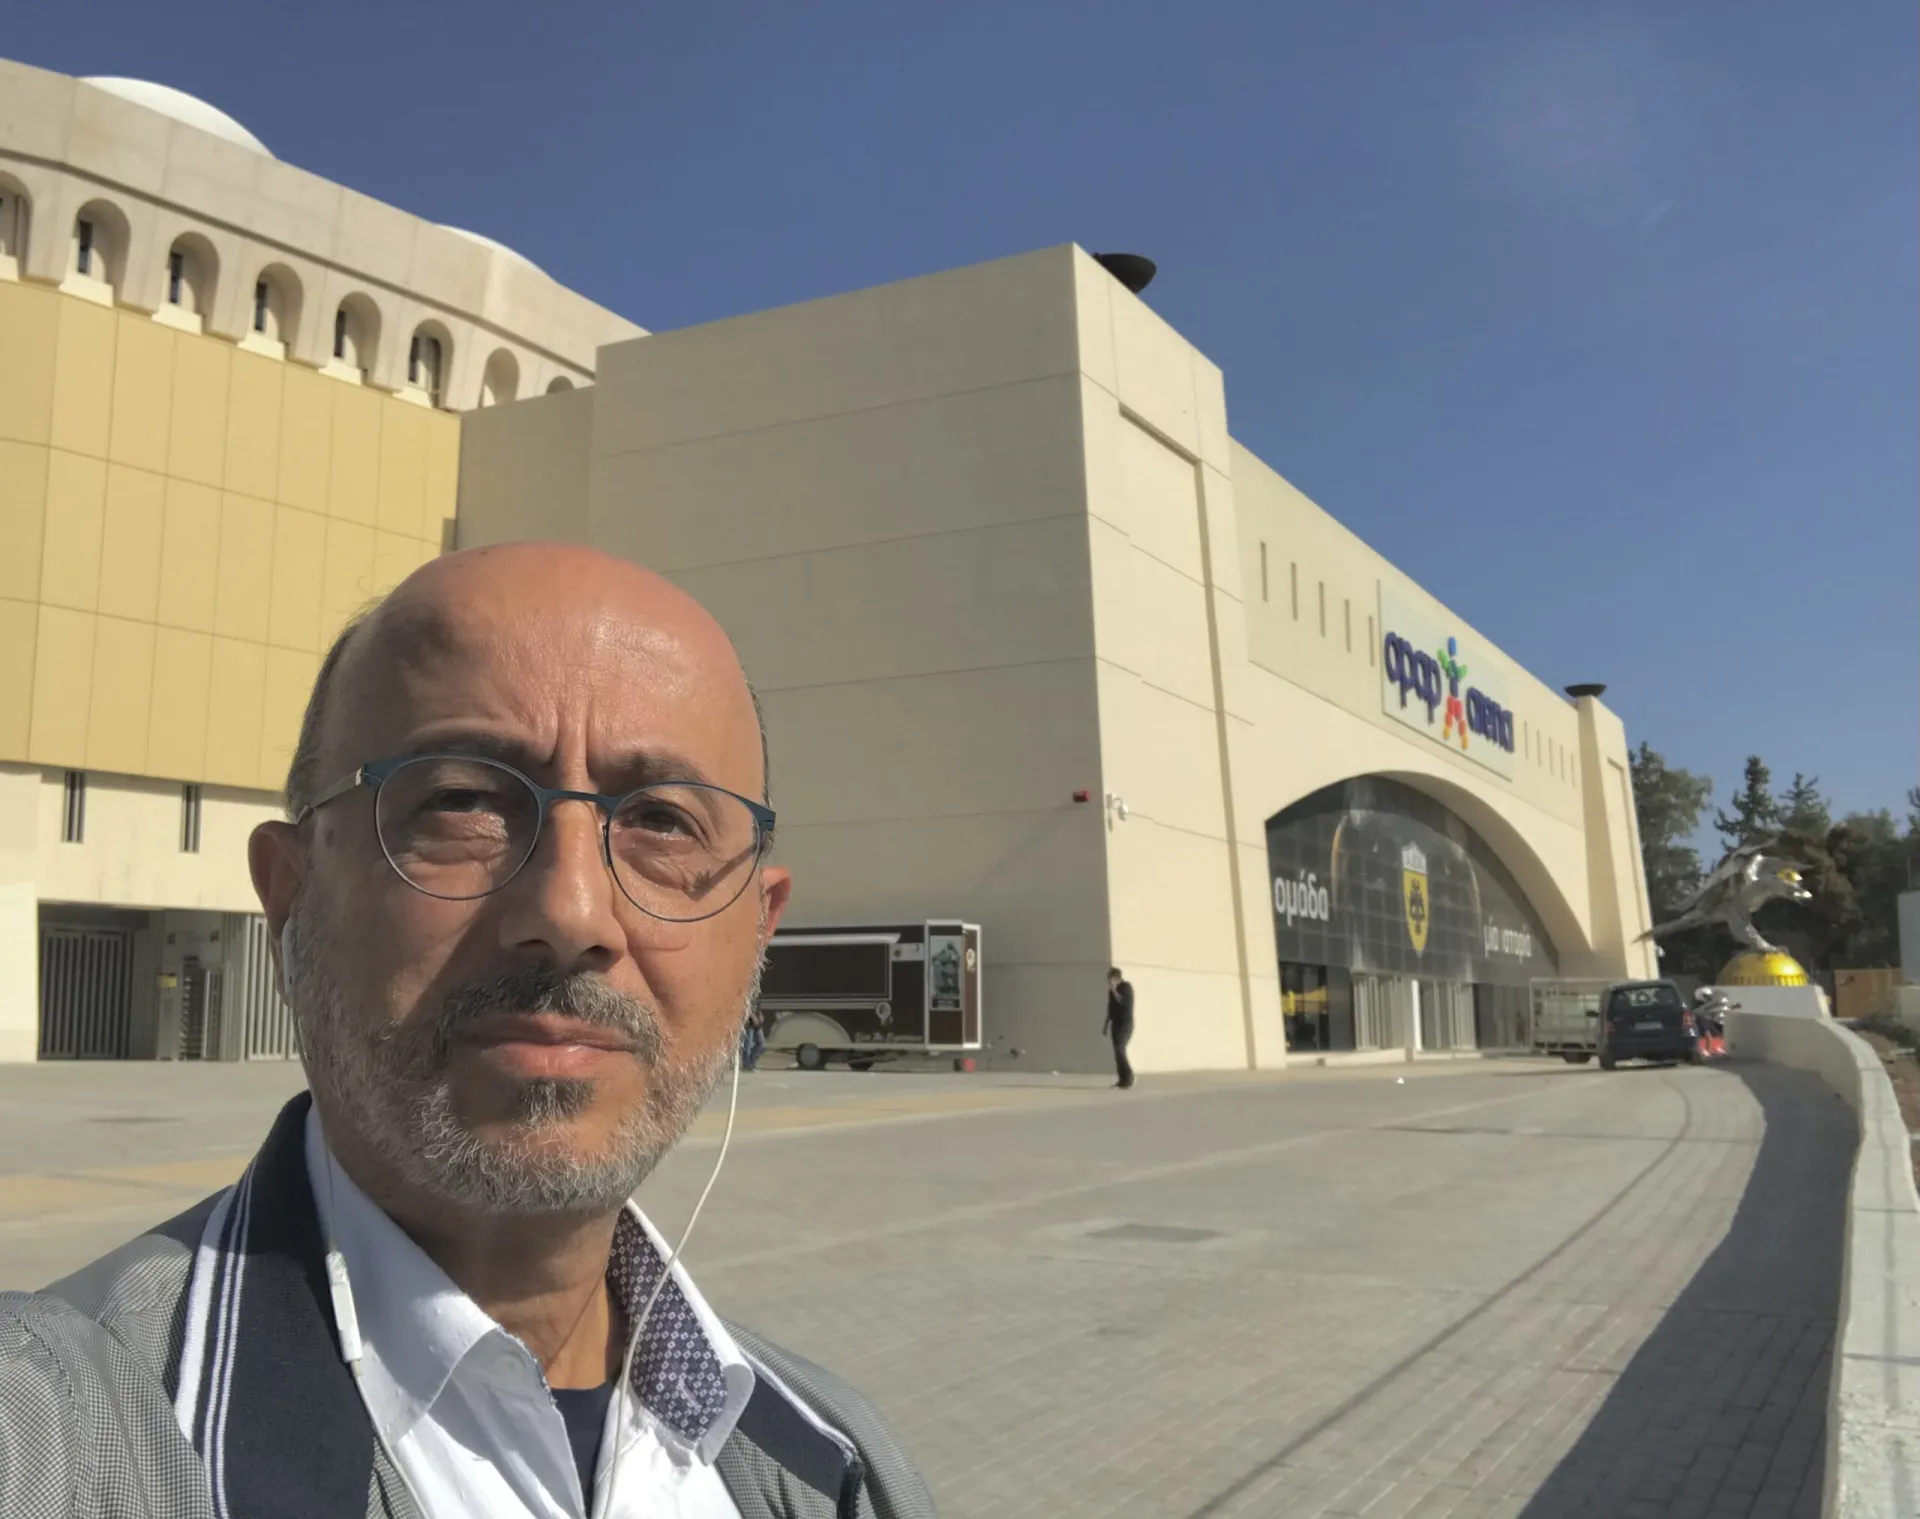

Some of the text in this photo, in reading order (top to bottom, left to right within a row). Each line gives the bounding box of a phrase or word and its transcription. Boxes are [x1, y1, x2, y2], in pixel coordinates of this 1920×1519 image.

[1385, 632, 1514, 752] opap arena
[1275, 869, 1329, 926] ομάδα
